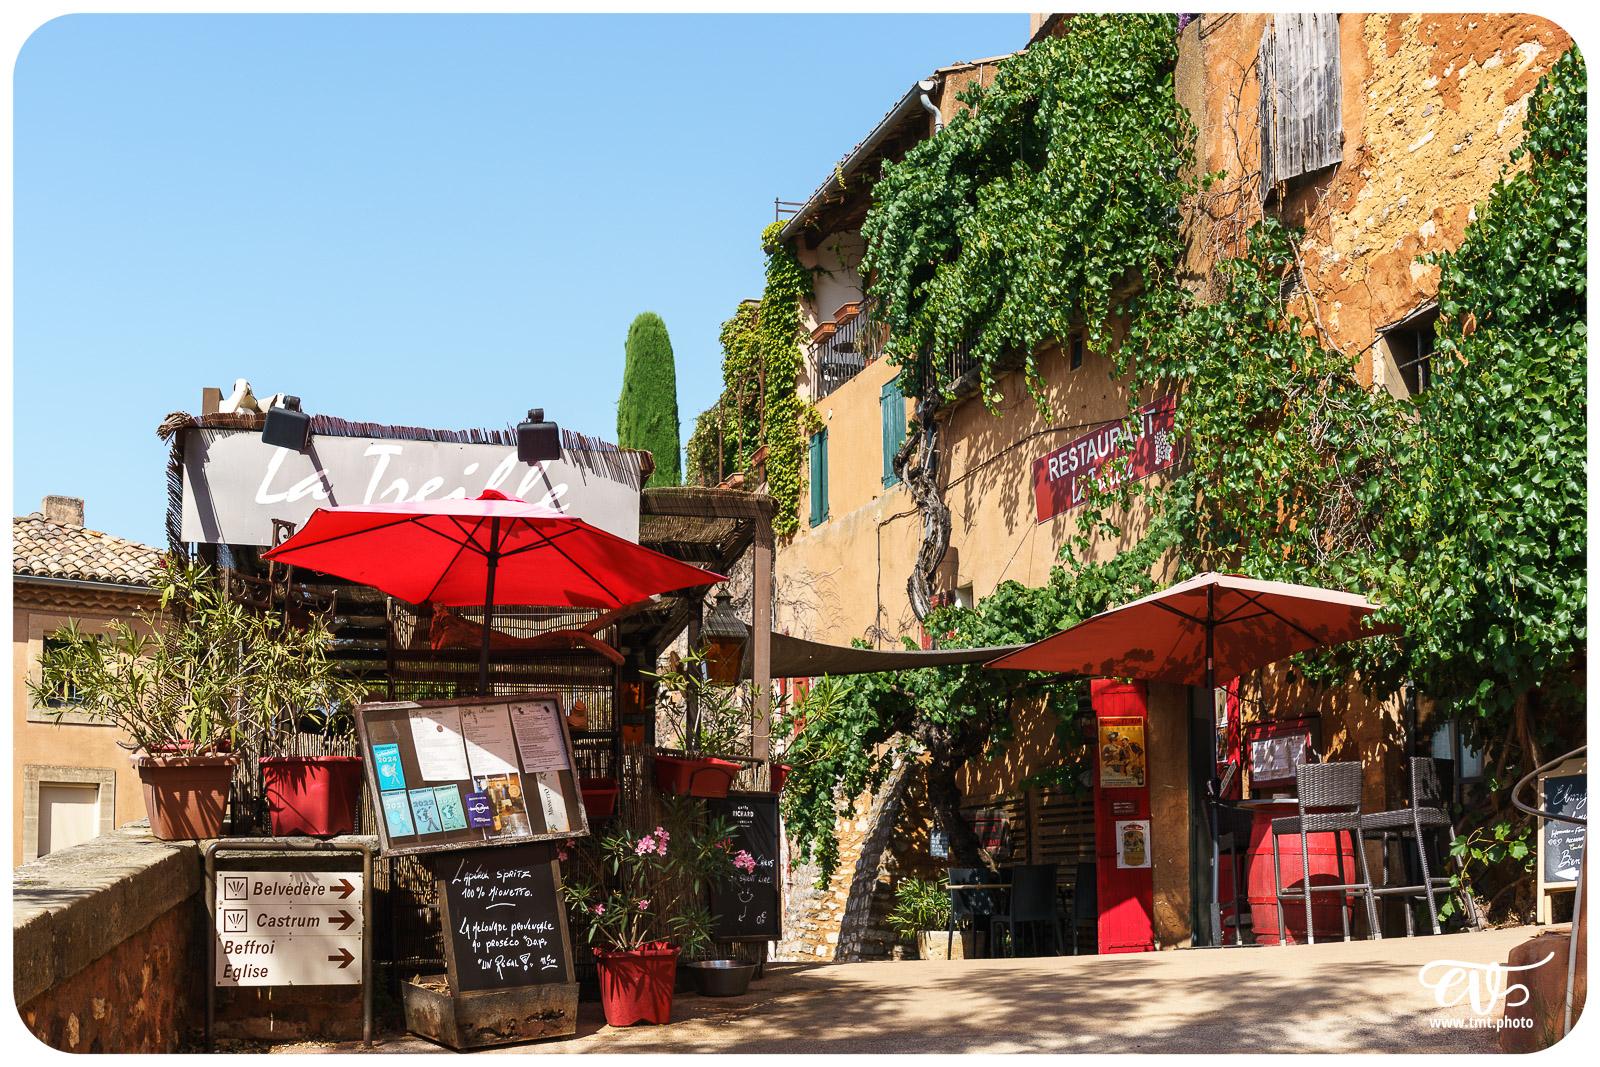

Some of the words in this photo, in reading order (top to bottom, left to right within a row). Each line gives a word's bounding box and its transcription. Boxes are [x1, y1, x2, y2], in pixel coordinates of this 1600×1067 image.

[254, 445, 332, 505] La
[364, 444, 572, 512] Treille
[386, 802, 405, 810] 2021
[413, 799, 434, 808] 2022
[732, 810, 754, 818] RICHARD
[253, 881, 326, 896] Belvédère
[256, 913, 320, 927] Castrum
[223, 940, 276, 955] Beffroi
[223, 963, 269, 982] Eglise
